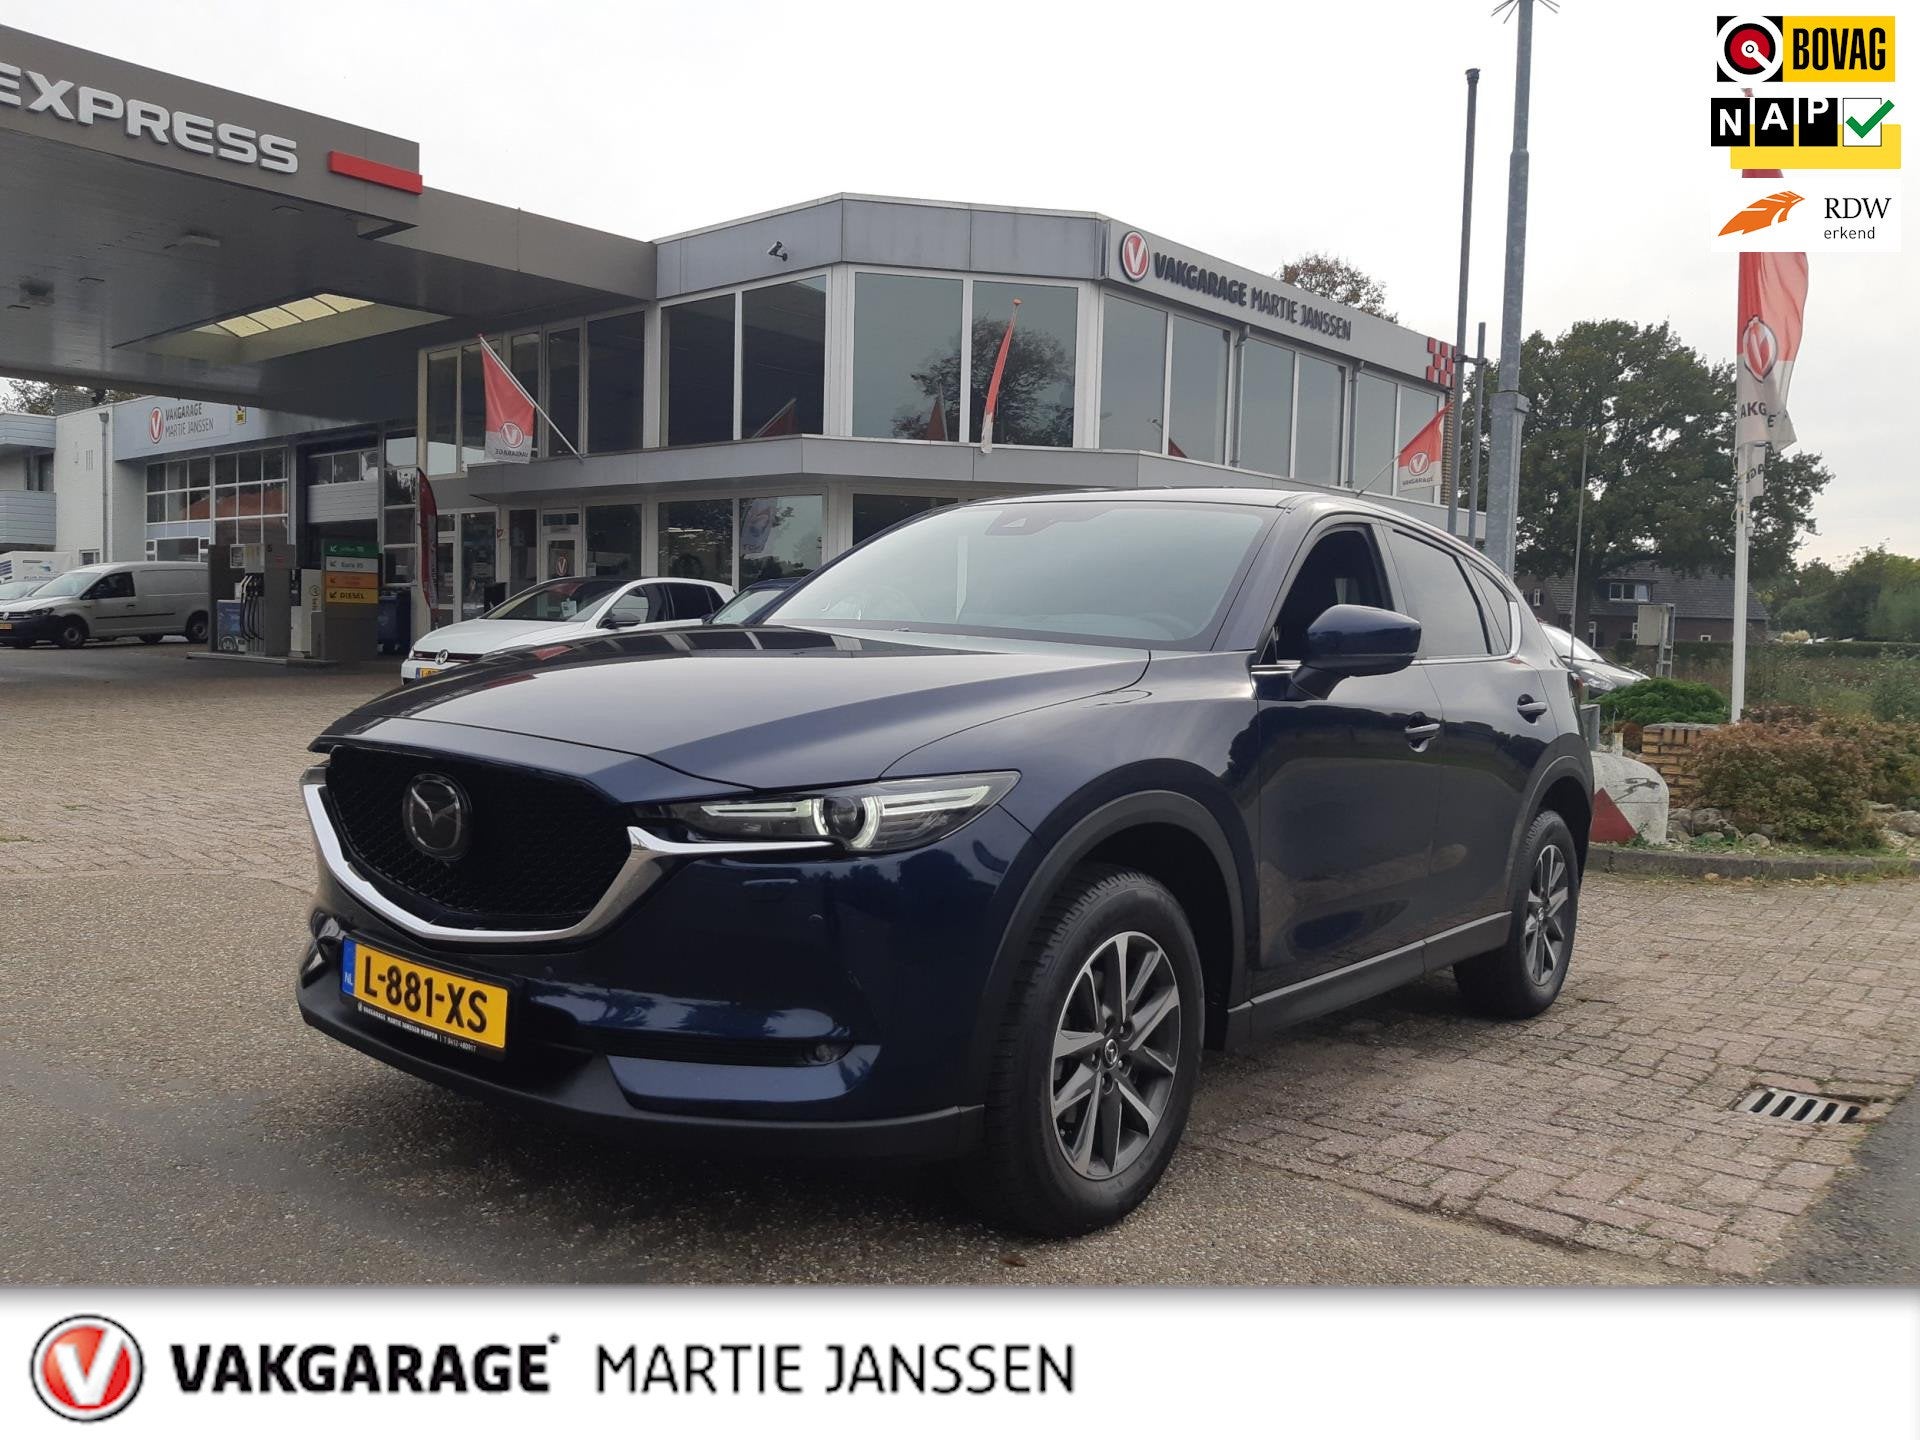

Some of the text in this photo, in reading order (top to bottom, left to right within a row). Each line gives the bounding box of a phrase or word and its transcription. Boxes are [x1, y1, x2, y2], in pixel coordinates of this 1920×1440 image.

[0, 62, 299, 174] EXPRESS
[1154, 252, 1247, 306] VAKGARAGE
[1250, 287, 1298, 323] MARTIE
[1300, 305, 1351, 341] JANSSEN
[165, 403, 202, 421] VAKGARAGE
[165, 418, 214, 438] MARTIE JANSSEN
[344, 972, 353, 986] NL
[364, 955, 488, 1033] L-881-XS
